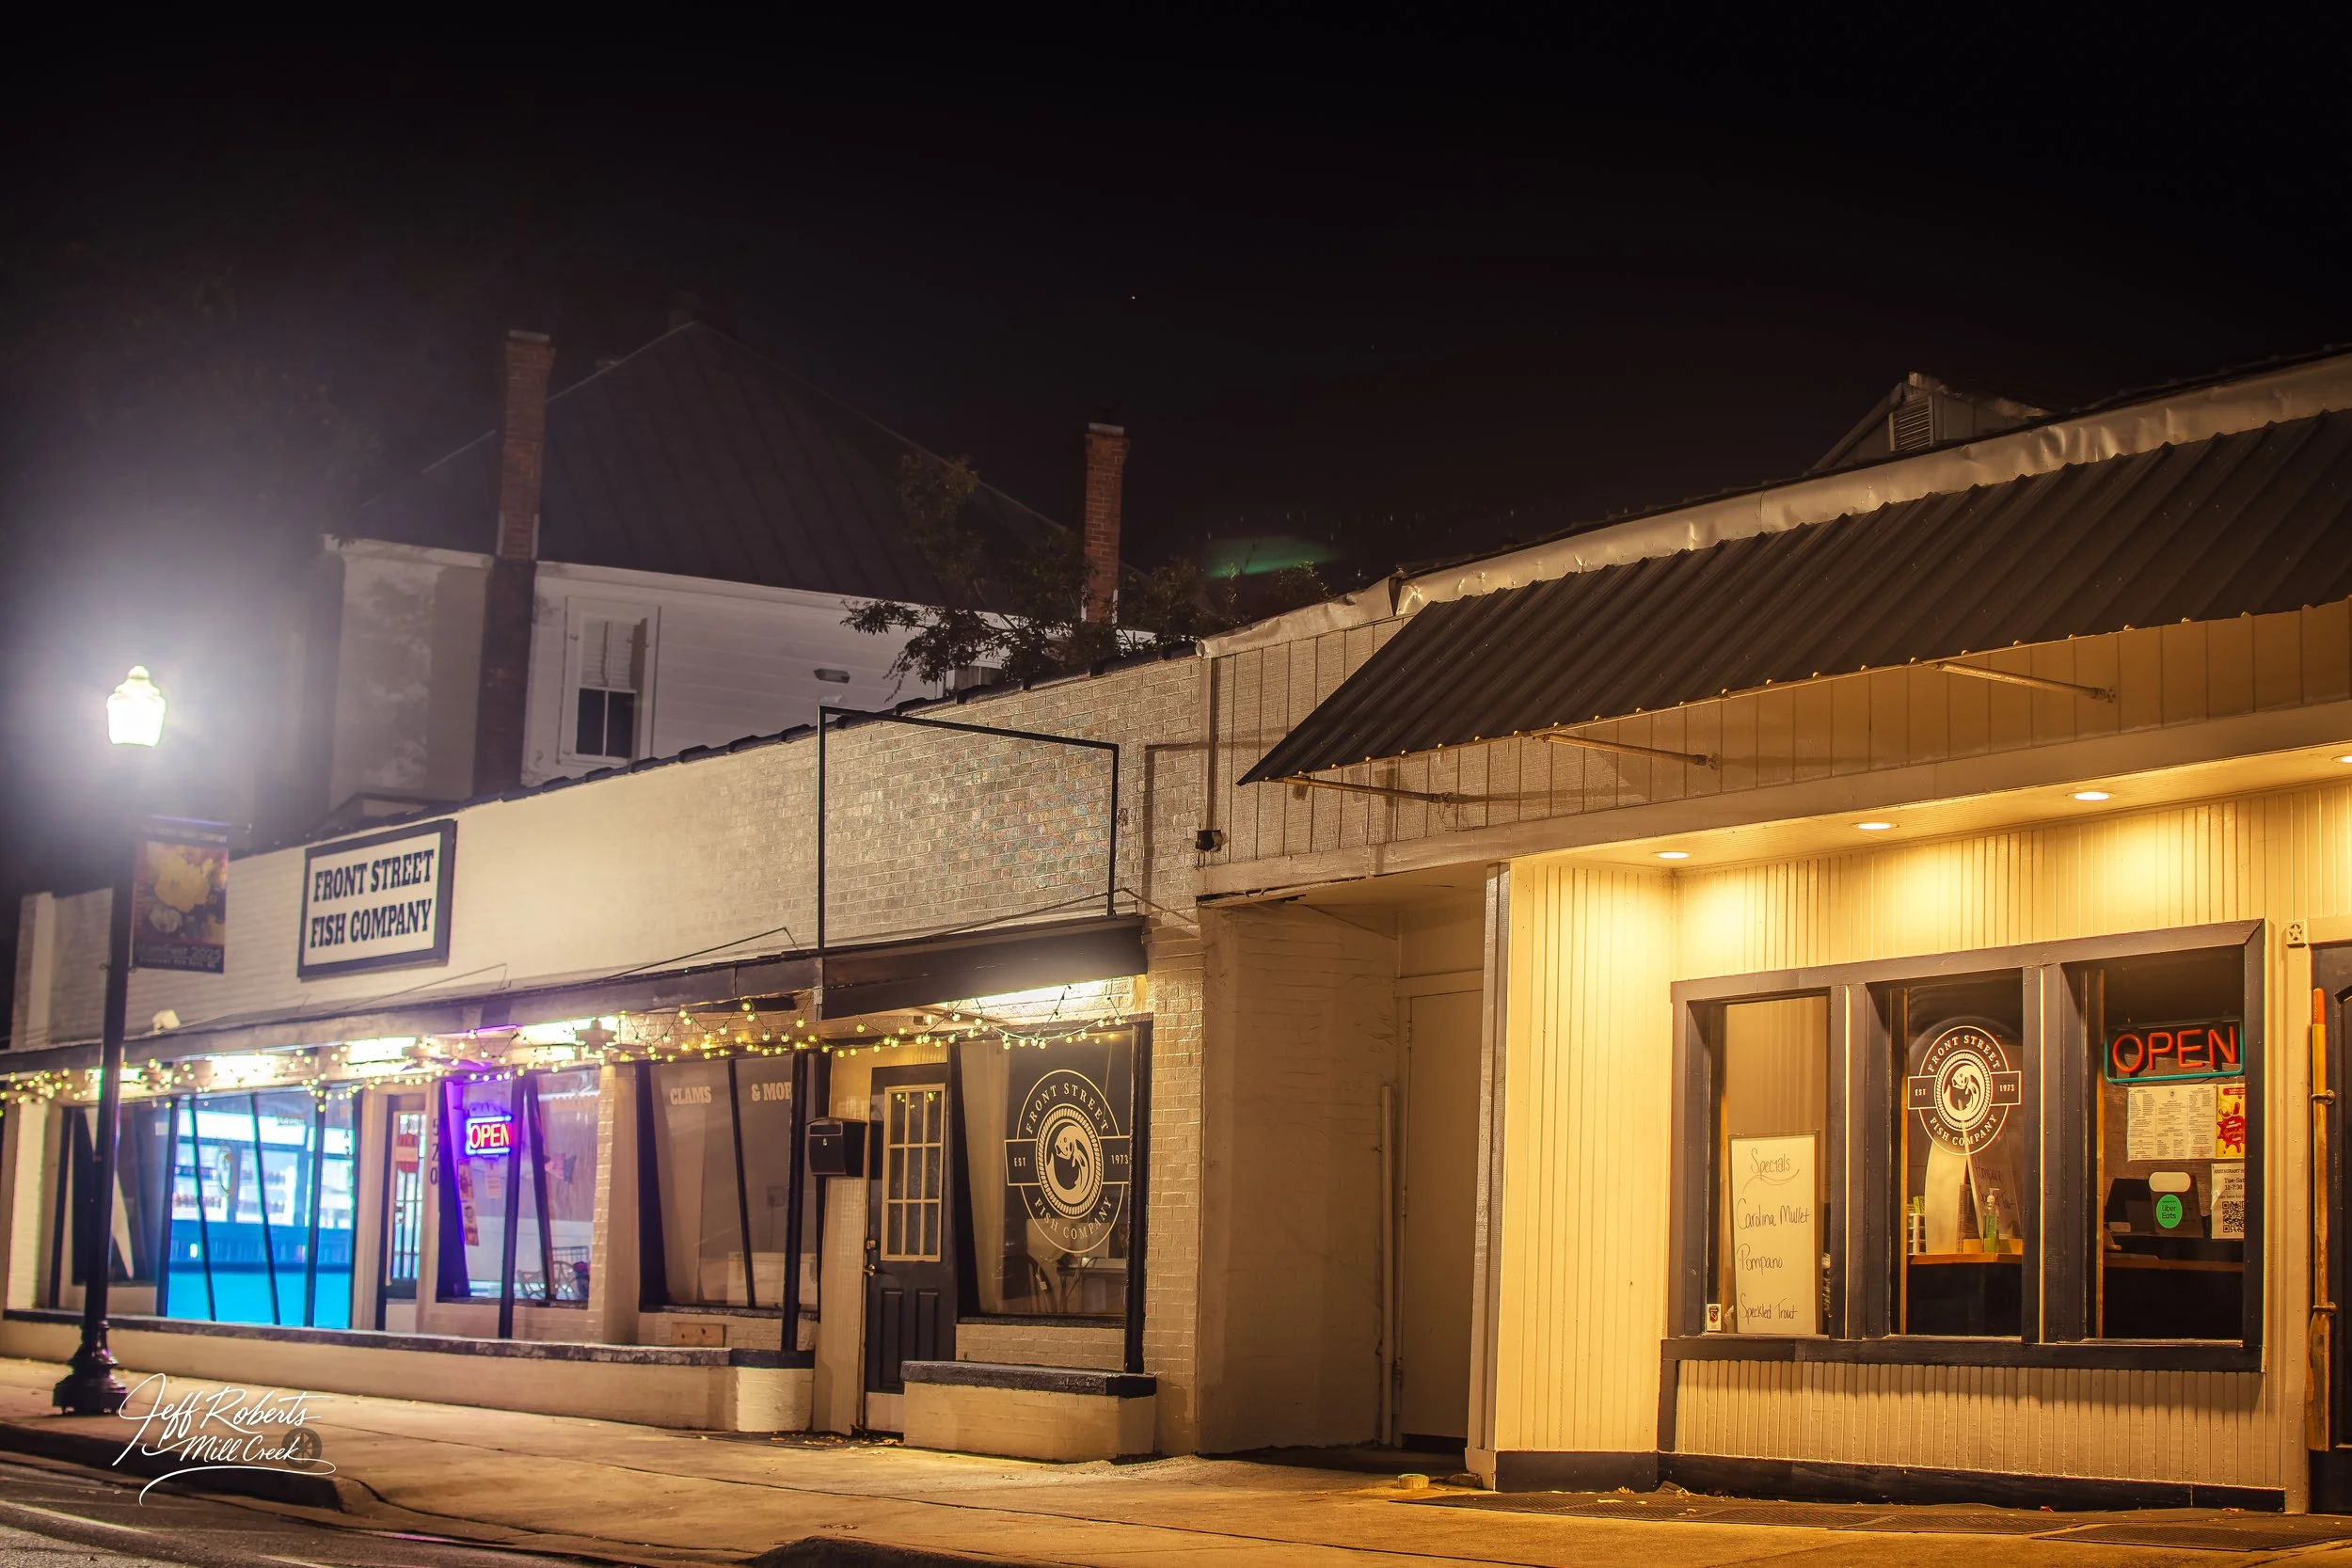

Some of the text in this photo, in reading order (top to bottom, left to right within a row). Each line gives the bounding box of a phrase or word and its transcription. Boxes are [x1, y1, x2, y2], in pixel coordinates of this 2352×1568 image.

[313, 849, 435, 902] FRONT STREET
[310, 898, 432, 948] FISH COMPANY
[1928, 1035, 2000, 1072] FRONT STREET
[2112, 1026, 2236, 1073] OPEN
[670, 1086, 712, 1105] CLAMS
[751, 1084, 760, 1101] &
[1025, 1083, 1108, 1134] FRONT STREET
[470, 1123, 510, 1148] OPEN
[1930, 1114, 1997, 1147] FISH COMPANY
[1013, 1157, 1026, 1166] EST
[1111, 1154, 1129, 1164] 1973
[1751, 1148, 1791, 1180] Specials
[1035, 1196, 1112, 1240] FISH COMPANY
[1737, 1198, 1810, 1229] Carolina Mullet
[1737, 1243, 1783, 1275] Pompano
[1740, 1293, 1772, 1324] Speckled
